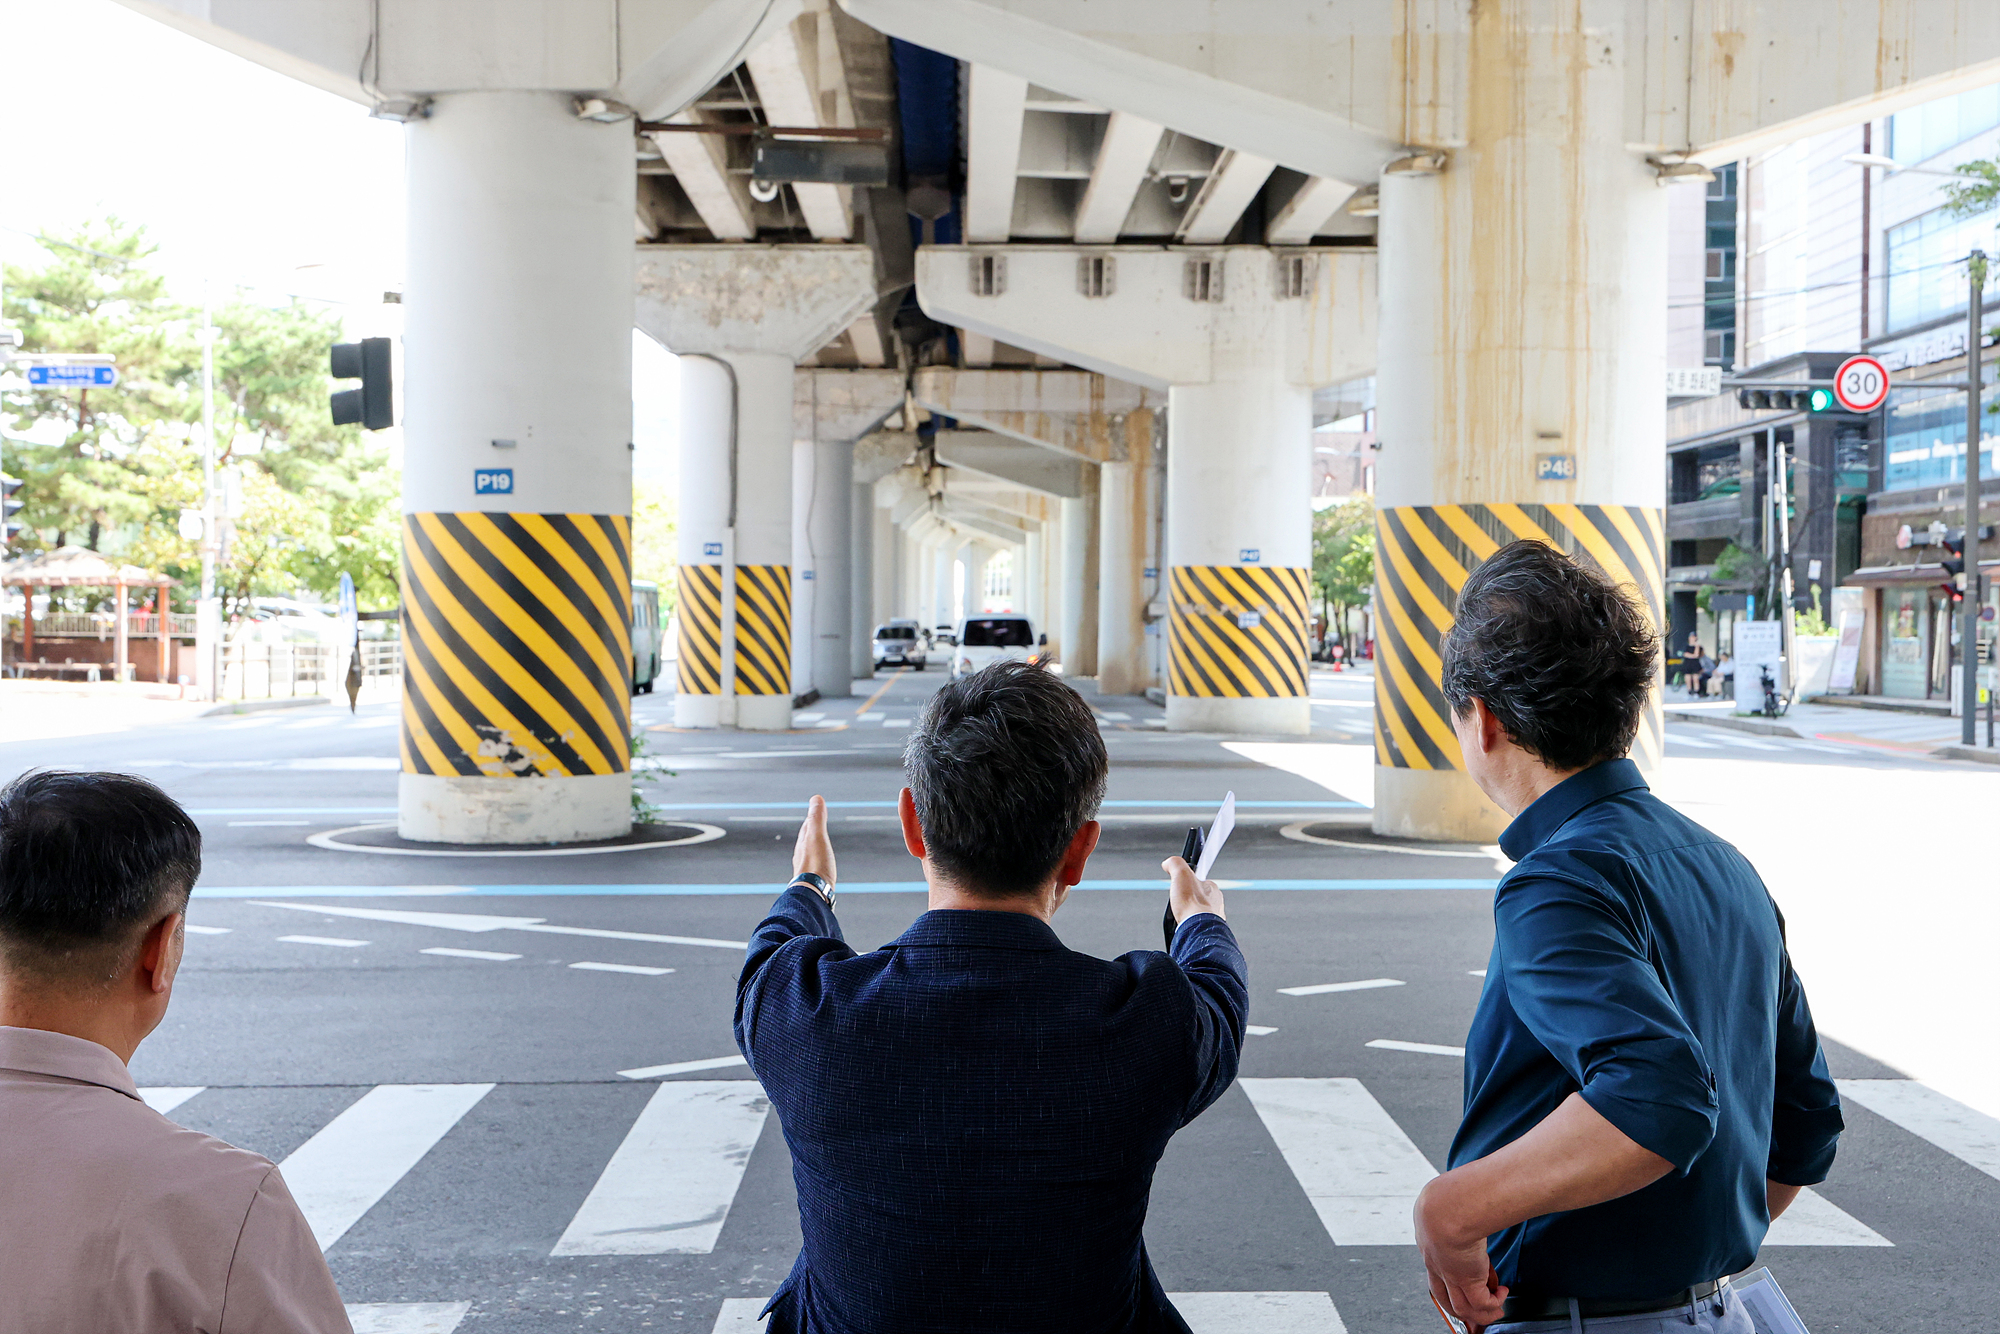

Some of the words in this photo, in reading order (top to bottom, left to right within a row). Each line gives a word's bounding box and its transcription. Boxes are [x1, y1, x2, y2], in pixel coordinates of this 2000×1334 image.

[1848, 373, 1877, 394] 30
[1539, 459, 1574, 476] P48
[477, 473, 510, 490] P19
